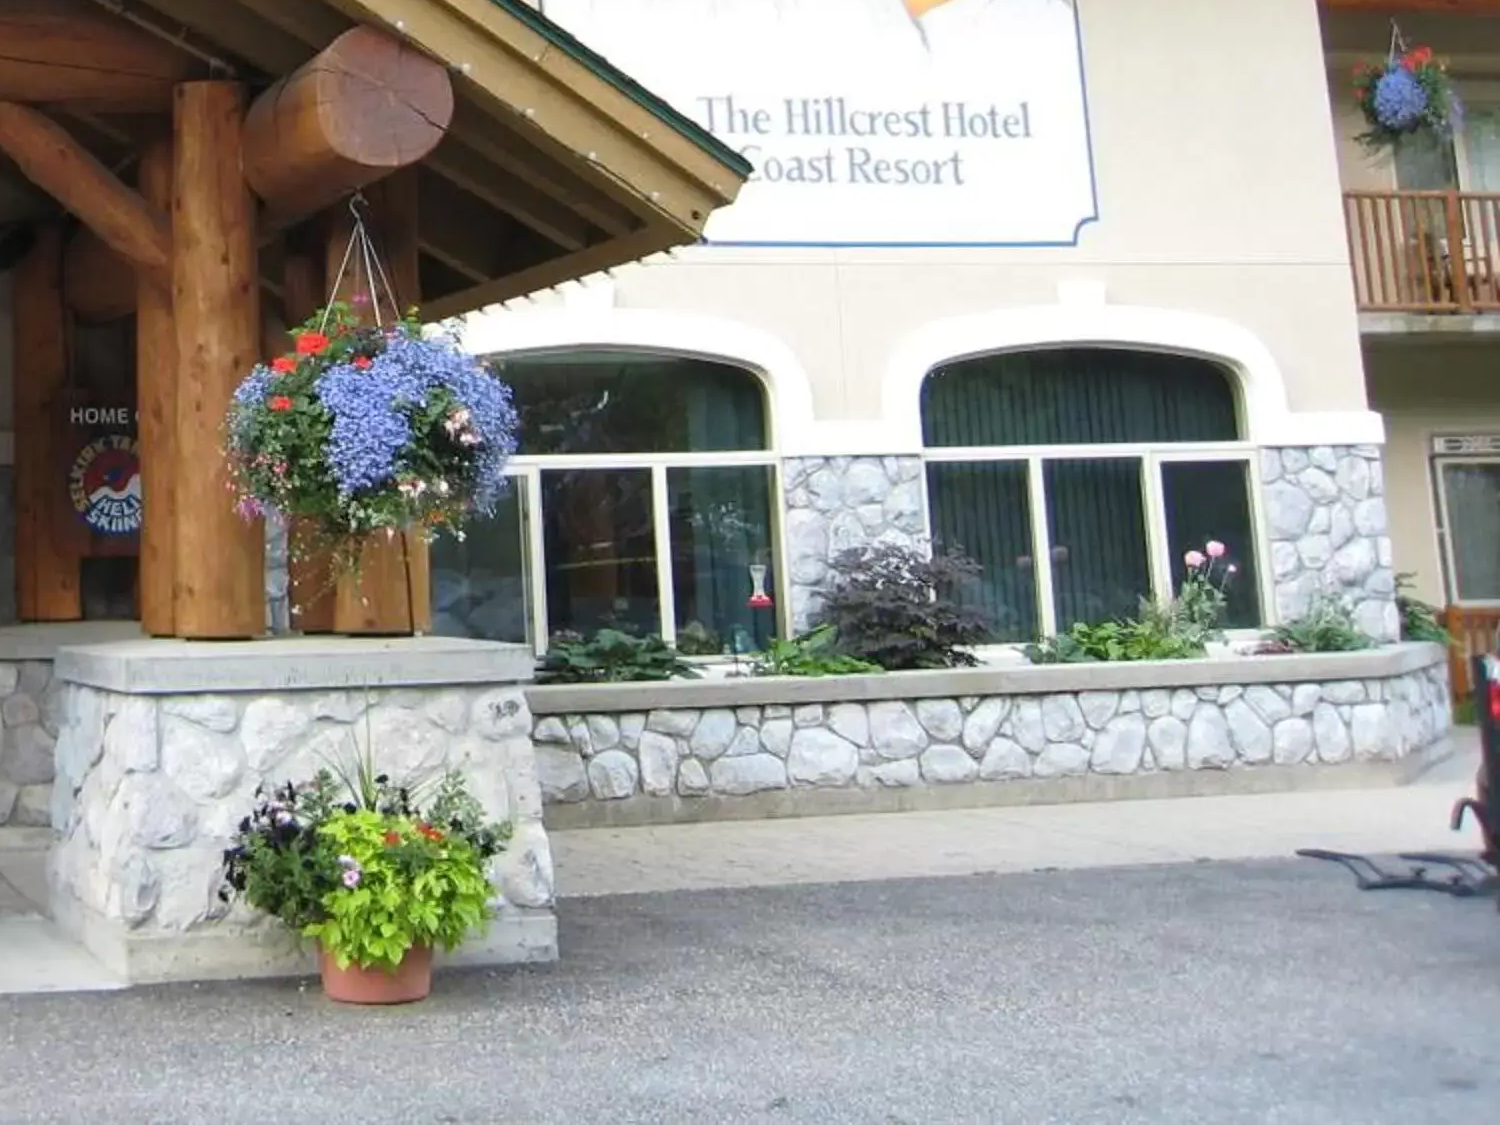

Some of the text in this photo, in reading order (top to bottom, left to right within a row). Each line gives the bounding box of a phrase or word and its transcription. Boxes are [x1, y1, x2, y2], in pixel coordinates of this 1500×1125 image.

[696, 93, 1033, 139] The Hillcrest Hotel
[738, 144, 965, 186] Coast Resort
[70, 407, 129, 424] HOME
